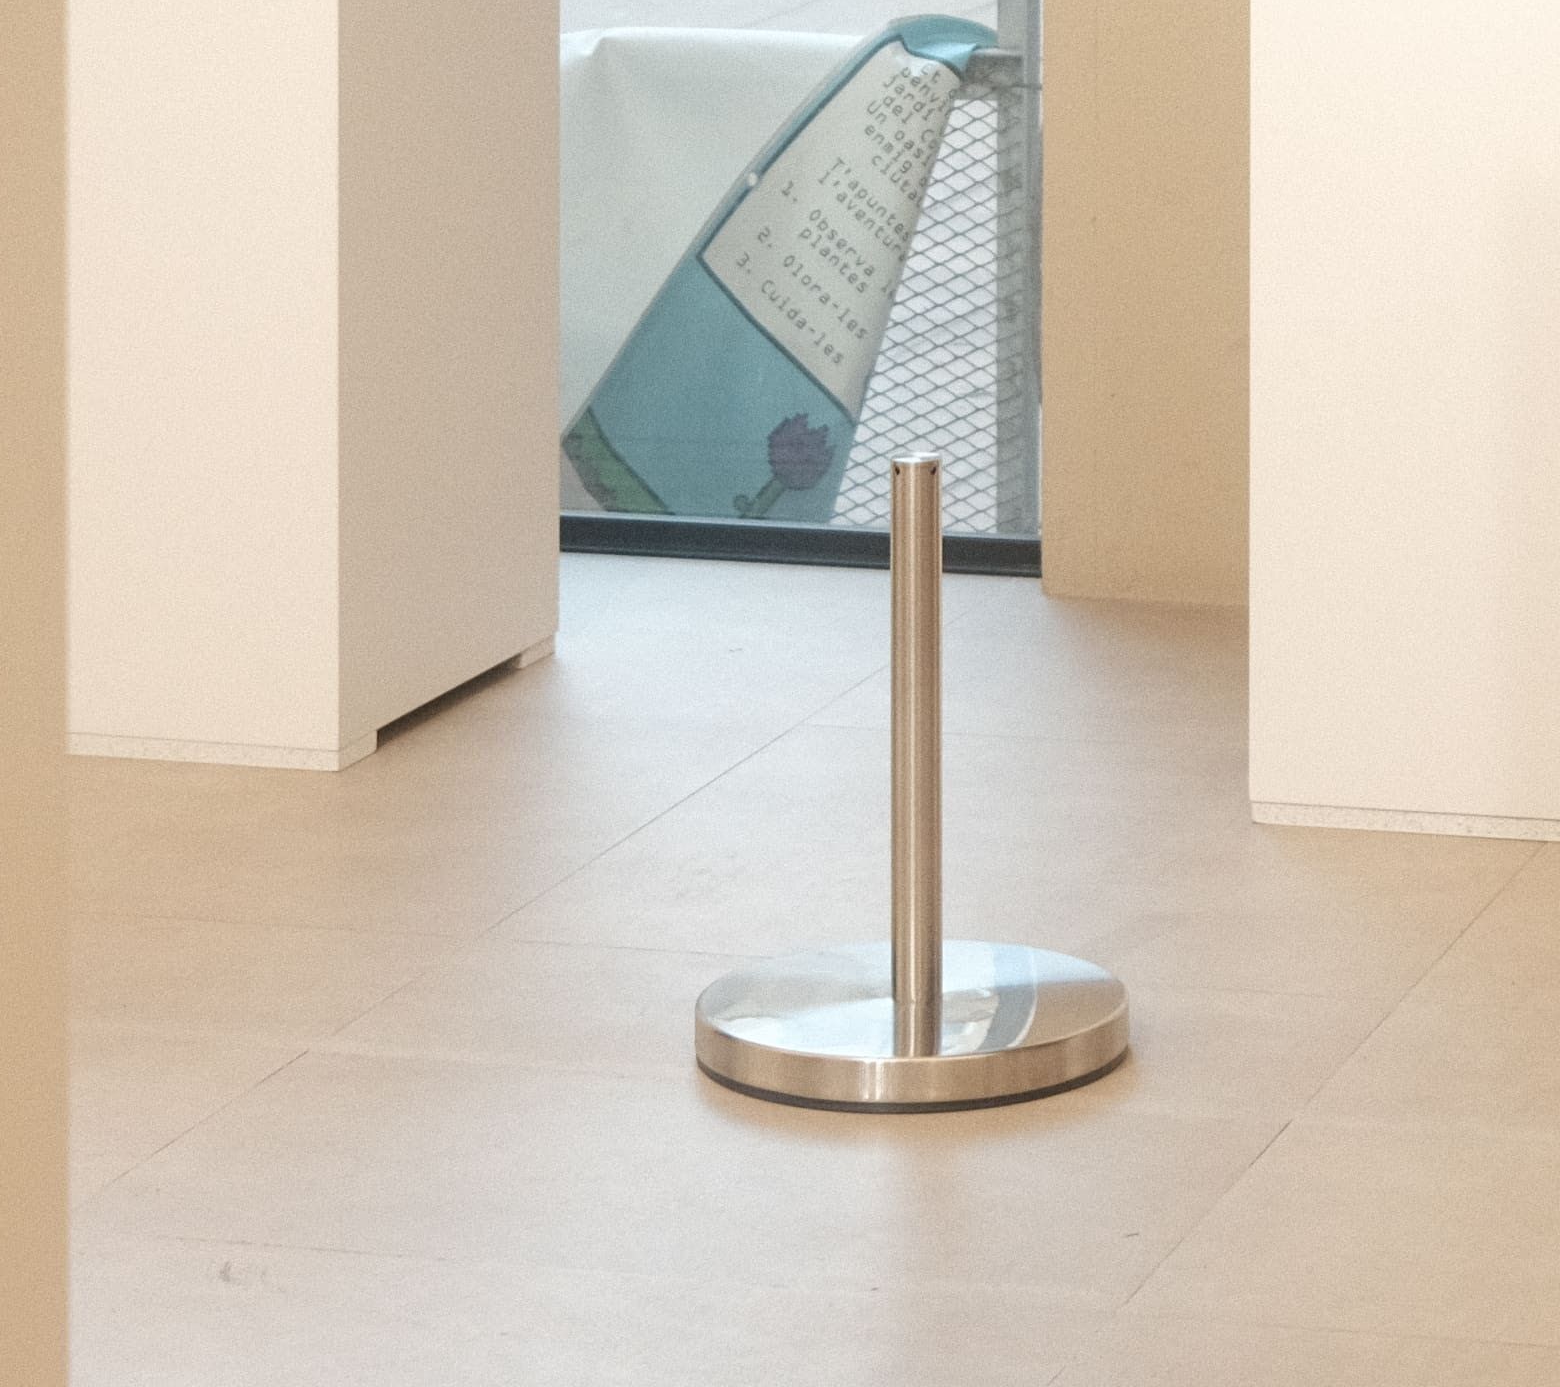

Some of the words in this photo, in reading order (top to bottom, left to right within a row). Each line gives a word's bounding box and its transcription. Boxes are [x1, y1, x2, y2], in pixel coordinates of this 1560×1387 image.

[864, 125, 913, 174] enmig
[866, 100, 888, 124] Un
[782, 180, 798, 203] 1.
[808, 209, 875, 277] Observa
[830, 156, 910, 242] T'apuntes
[757, 226, 773, 249] 2.
[783, 254, 869, 339] Olora-les
[797, 228, 870, 294] plantes
[736, 252, 752, 275] 3.
[761, 279, 845, 364] Cuida-les
